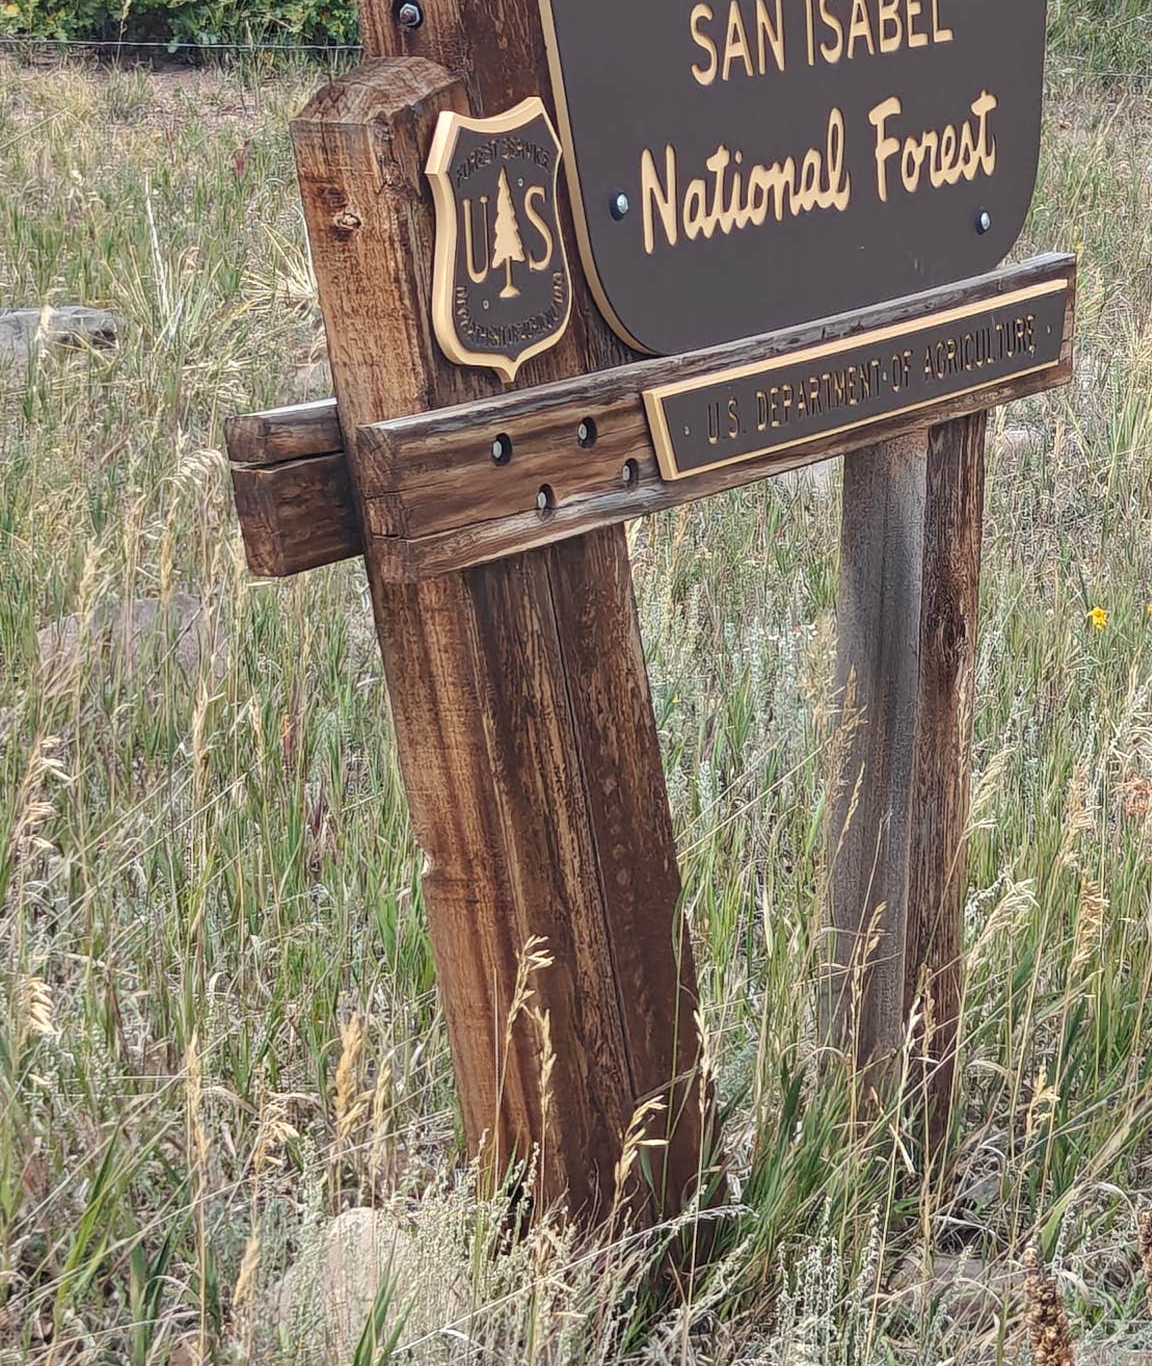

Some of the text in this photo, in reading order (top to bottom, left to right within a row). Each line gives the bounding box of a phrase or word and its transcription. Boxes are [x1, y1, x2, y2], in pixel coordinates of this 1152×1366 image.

[641, 90, 997, 254] National Forest
[756, 359, 880, 431] DEPARTMENT
[891, 349, 913, 393] OF
[924, 315, 1036, 381] AGRICULTURE
